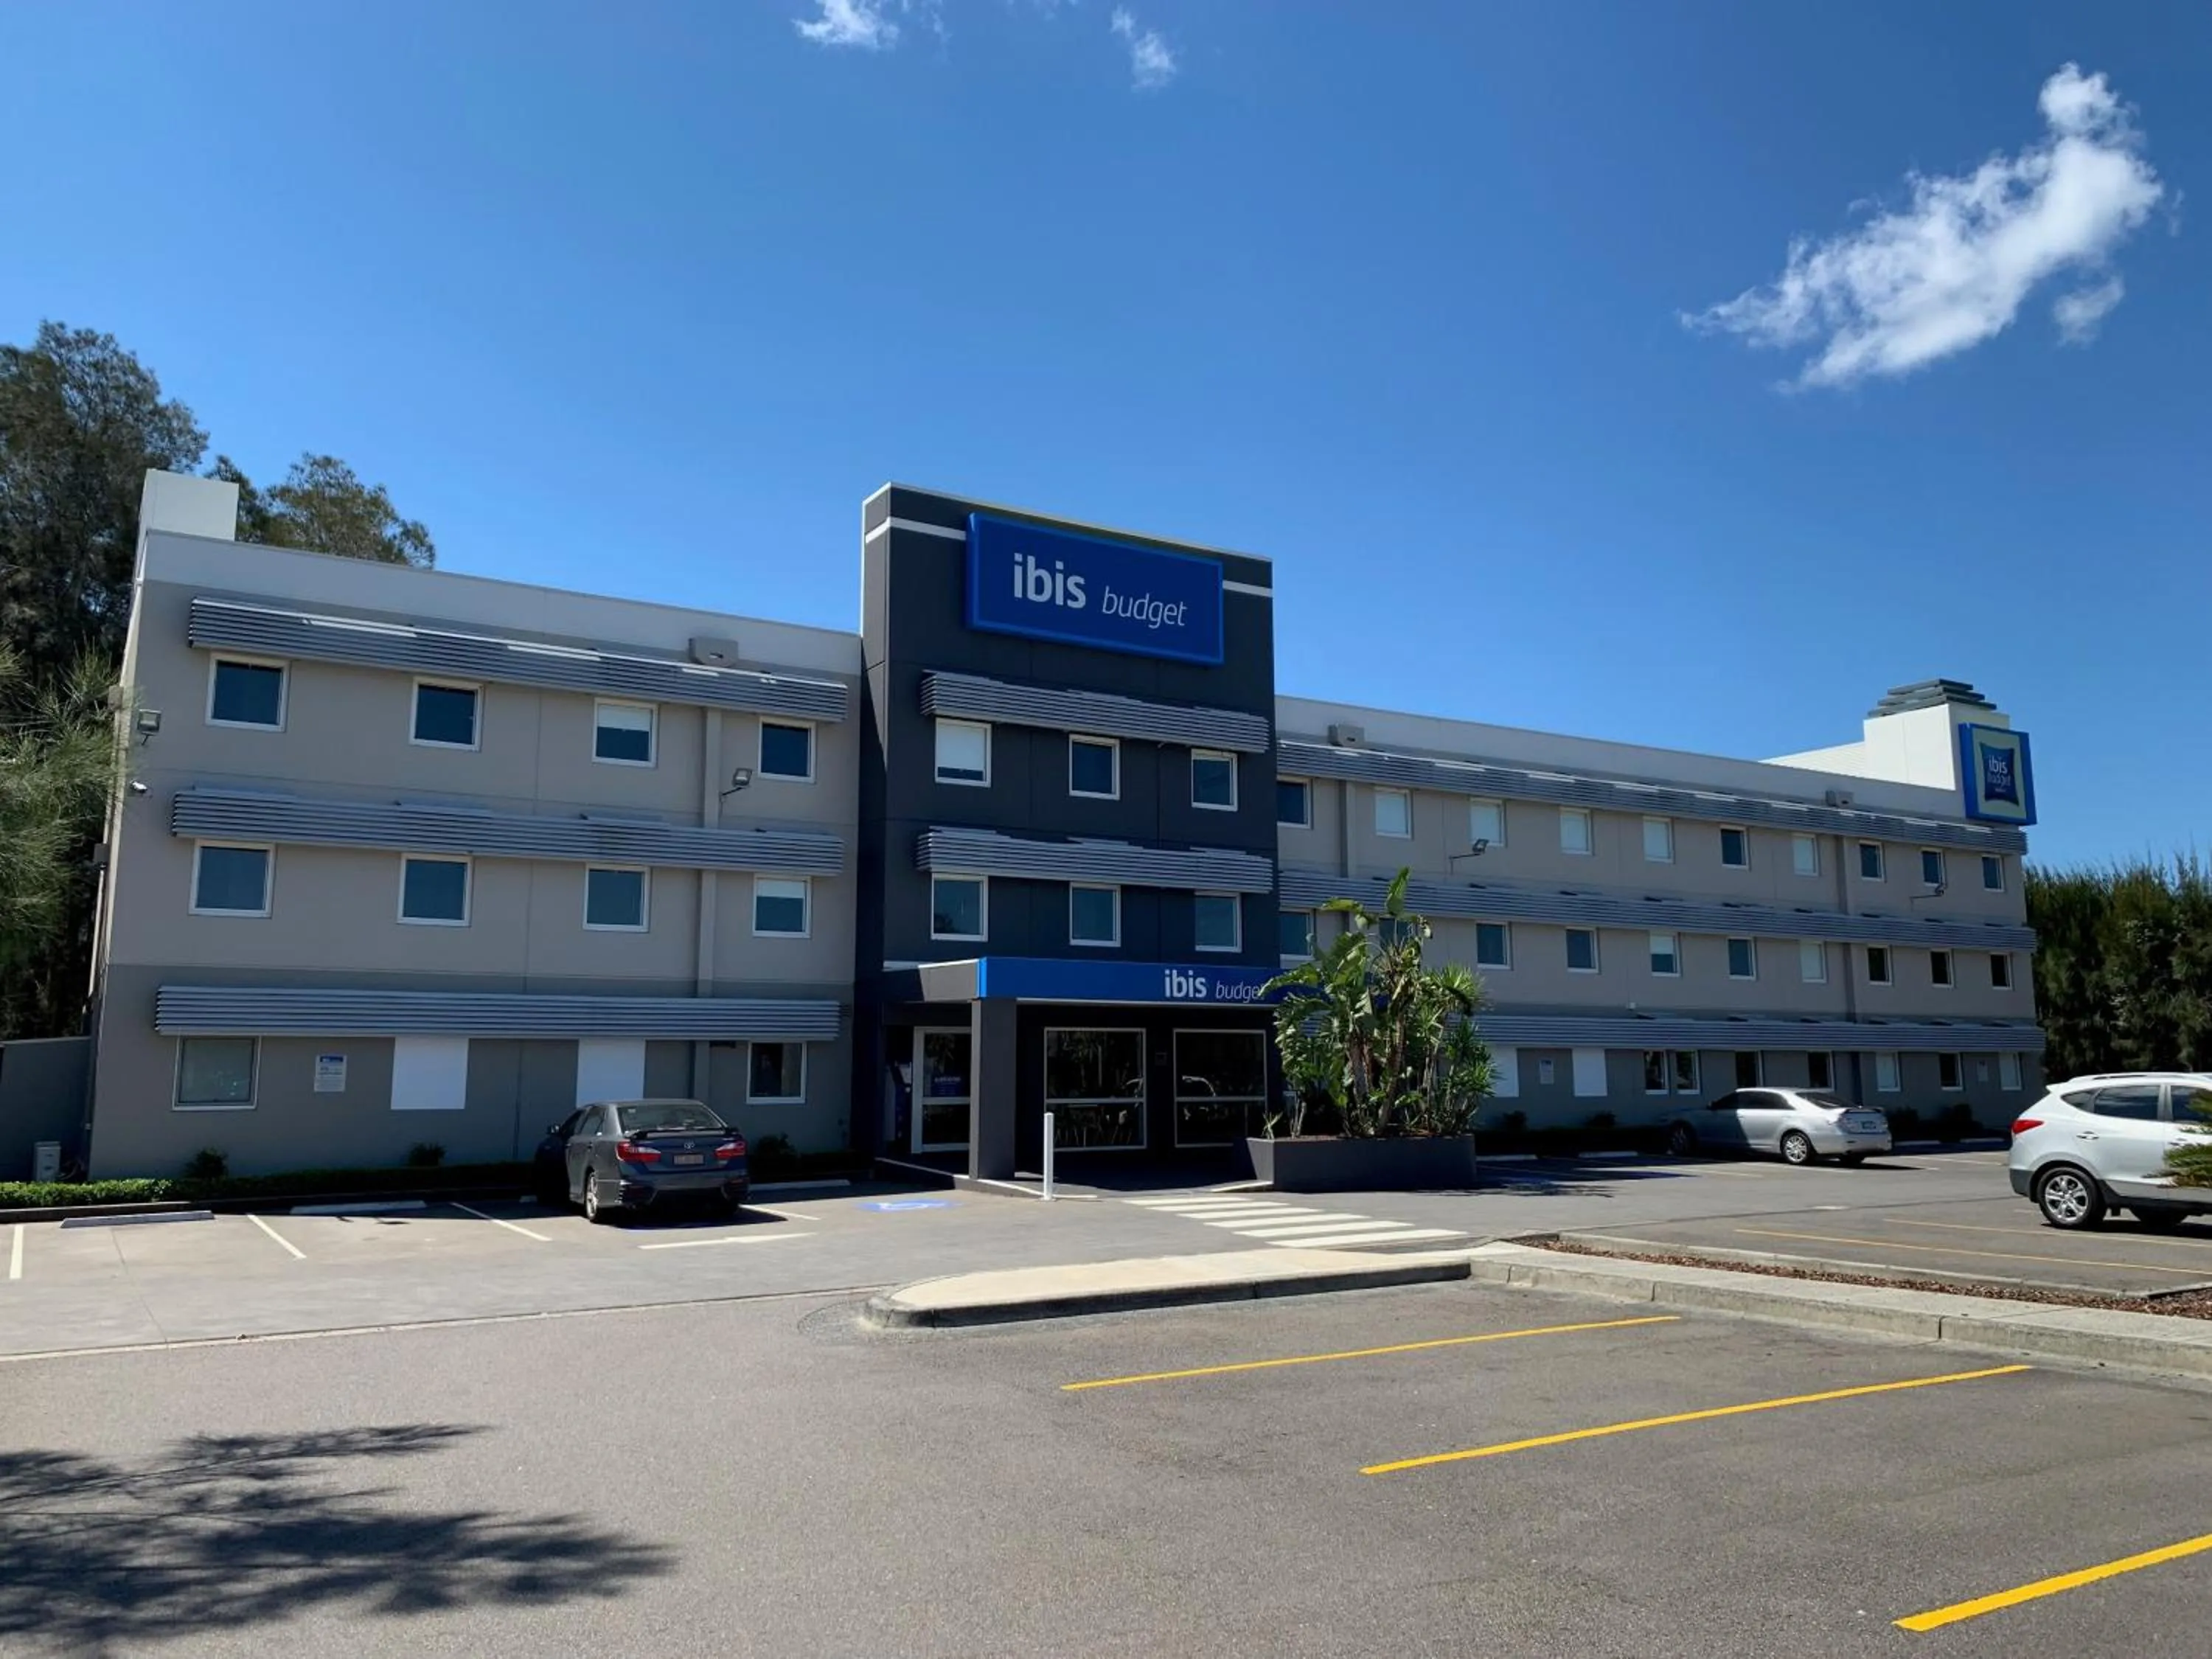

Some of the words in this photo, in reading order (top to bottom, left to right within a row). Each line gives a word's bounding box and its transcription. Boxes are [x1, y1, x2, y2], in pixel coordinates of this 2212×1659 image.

[1014, 552, 1086, 608] ibis
[1102, 585, 1187, 629] budget
[1989, 754, 2008, 774] ibis
[1164, 969, 1207, 998] ibis
